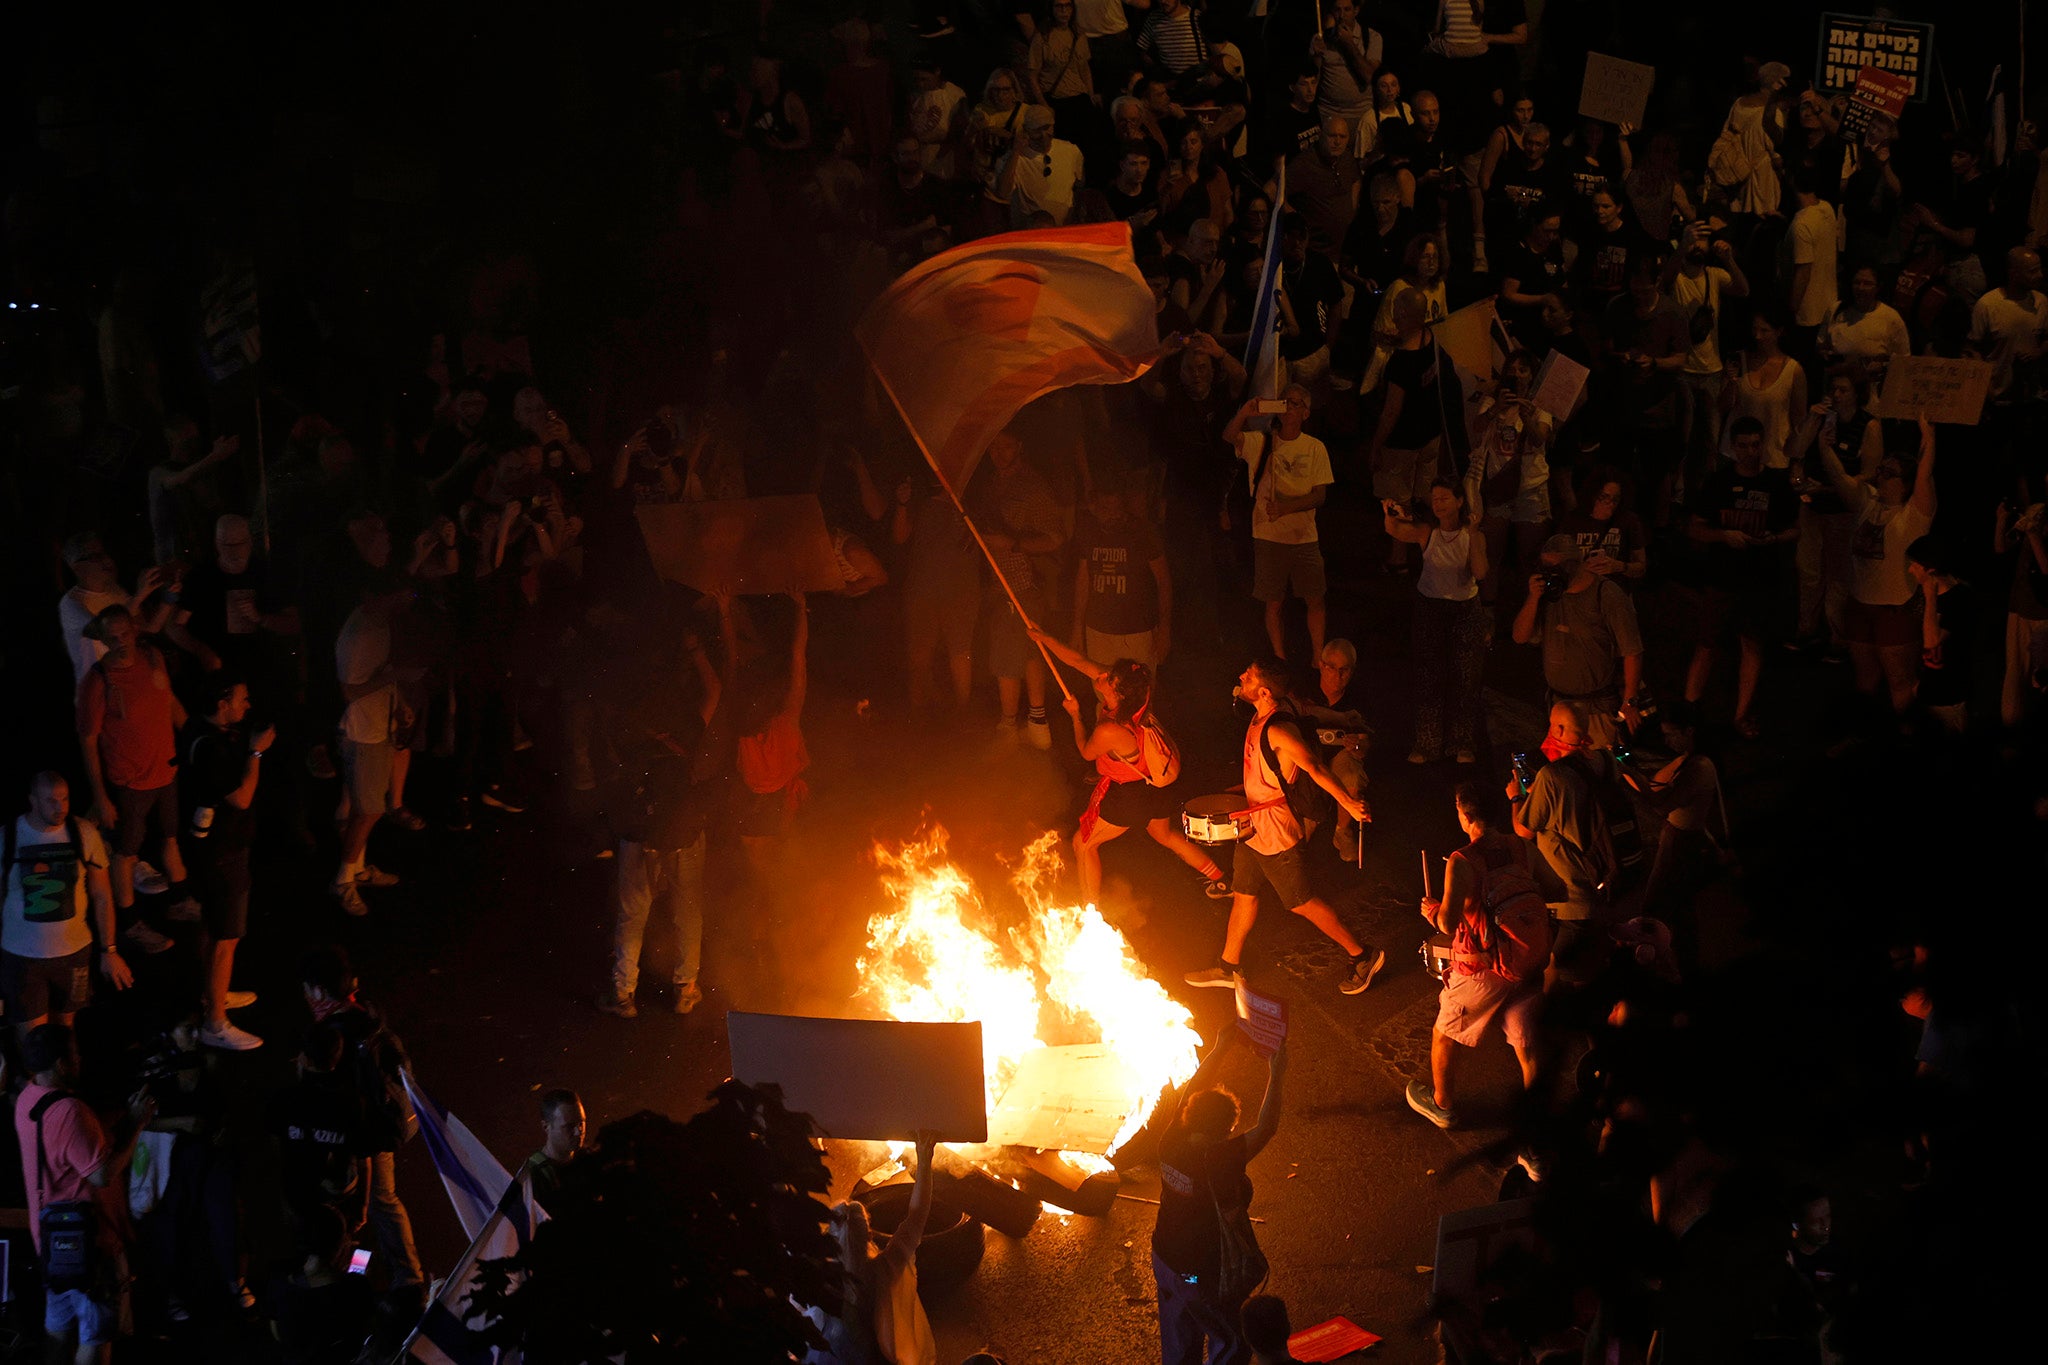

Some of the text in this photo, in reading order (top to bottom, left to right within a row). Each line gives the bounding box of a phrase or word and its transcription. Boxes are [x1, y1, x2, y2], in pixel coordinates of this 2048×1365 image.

[1829, 28, 1919, 54] לסיים את
[1827, 46, 1918, 72] המלחמה
